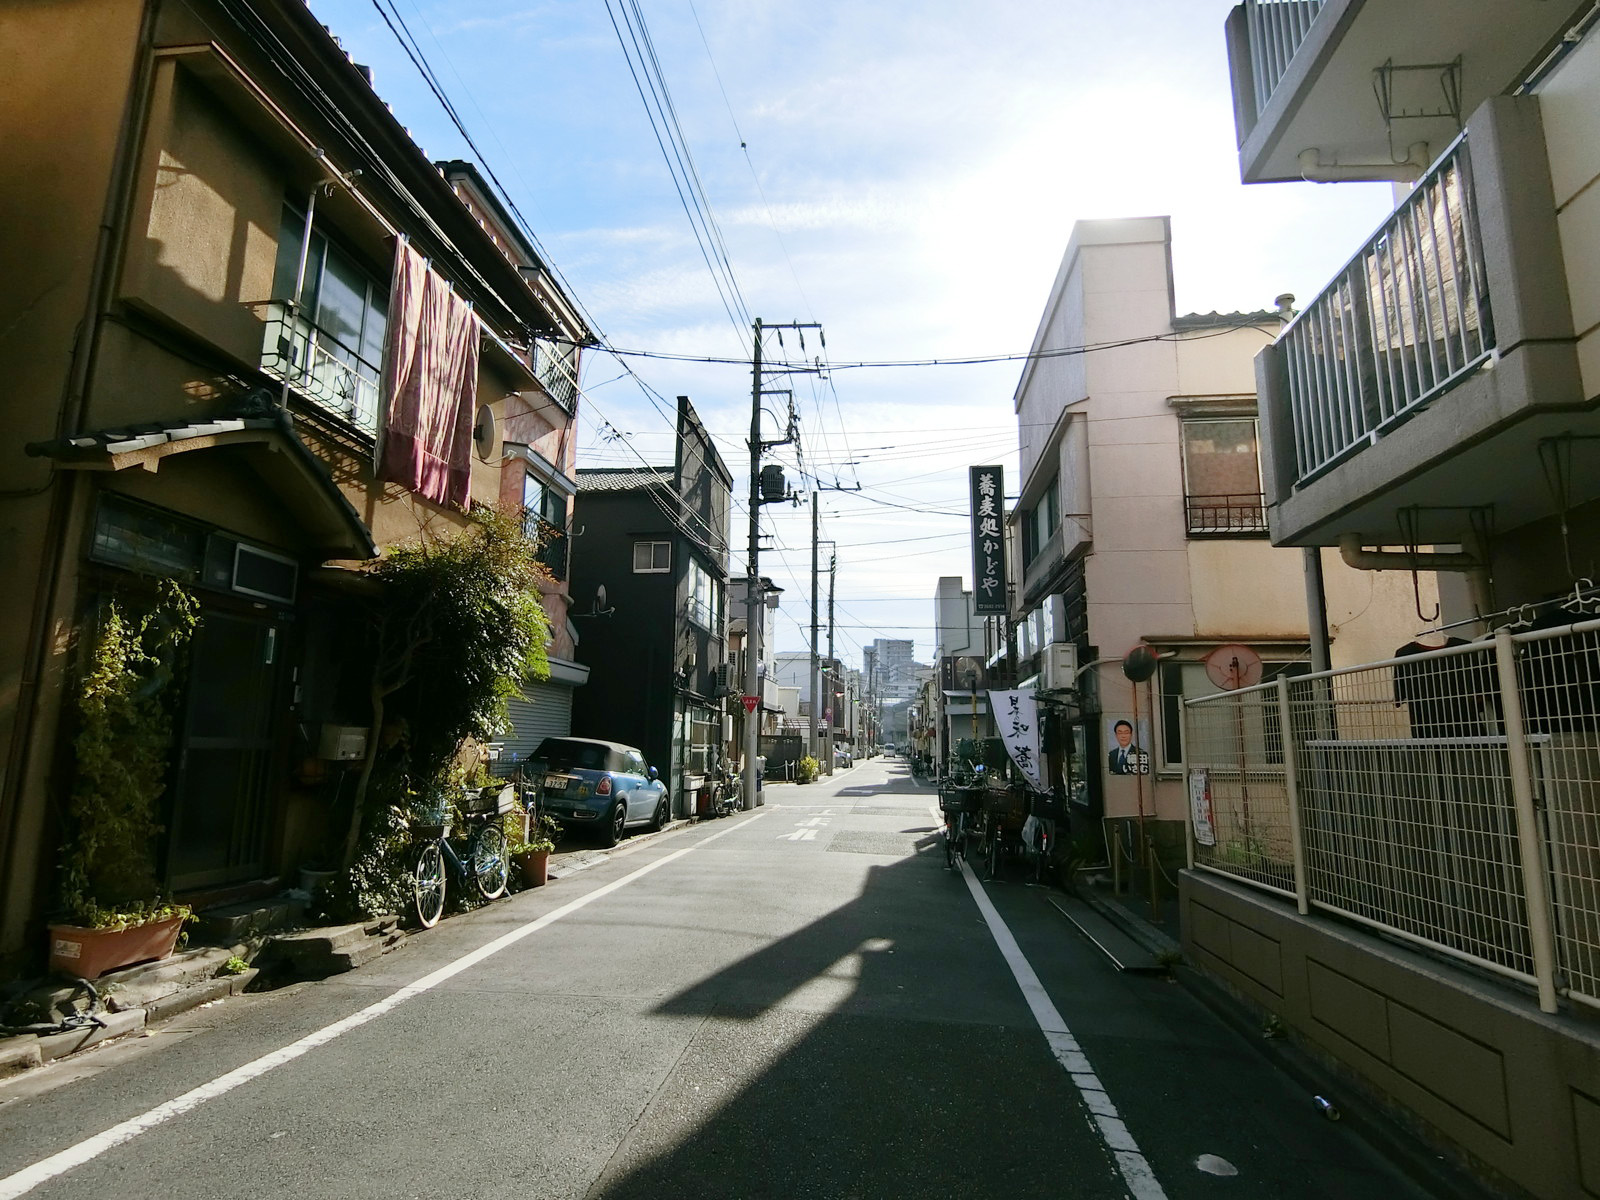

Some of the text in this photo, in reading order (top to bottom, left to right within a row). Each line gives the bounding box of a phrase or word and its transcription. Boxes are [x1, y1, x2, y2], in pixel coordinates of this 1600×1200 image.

[977, 473, 1001, 598] 蕎麦処かどや
